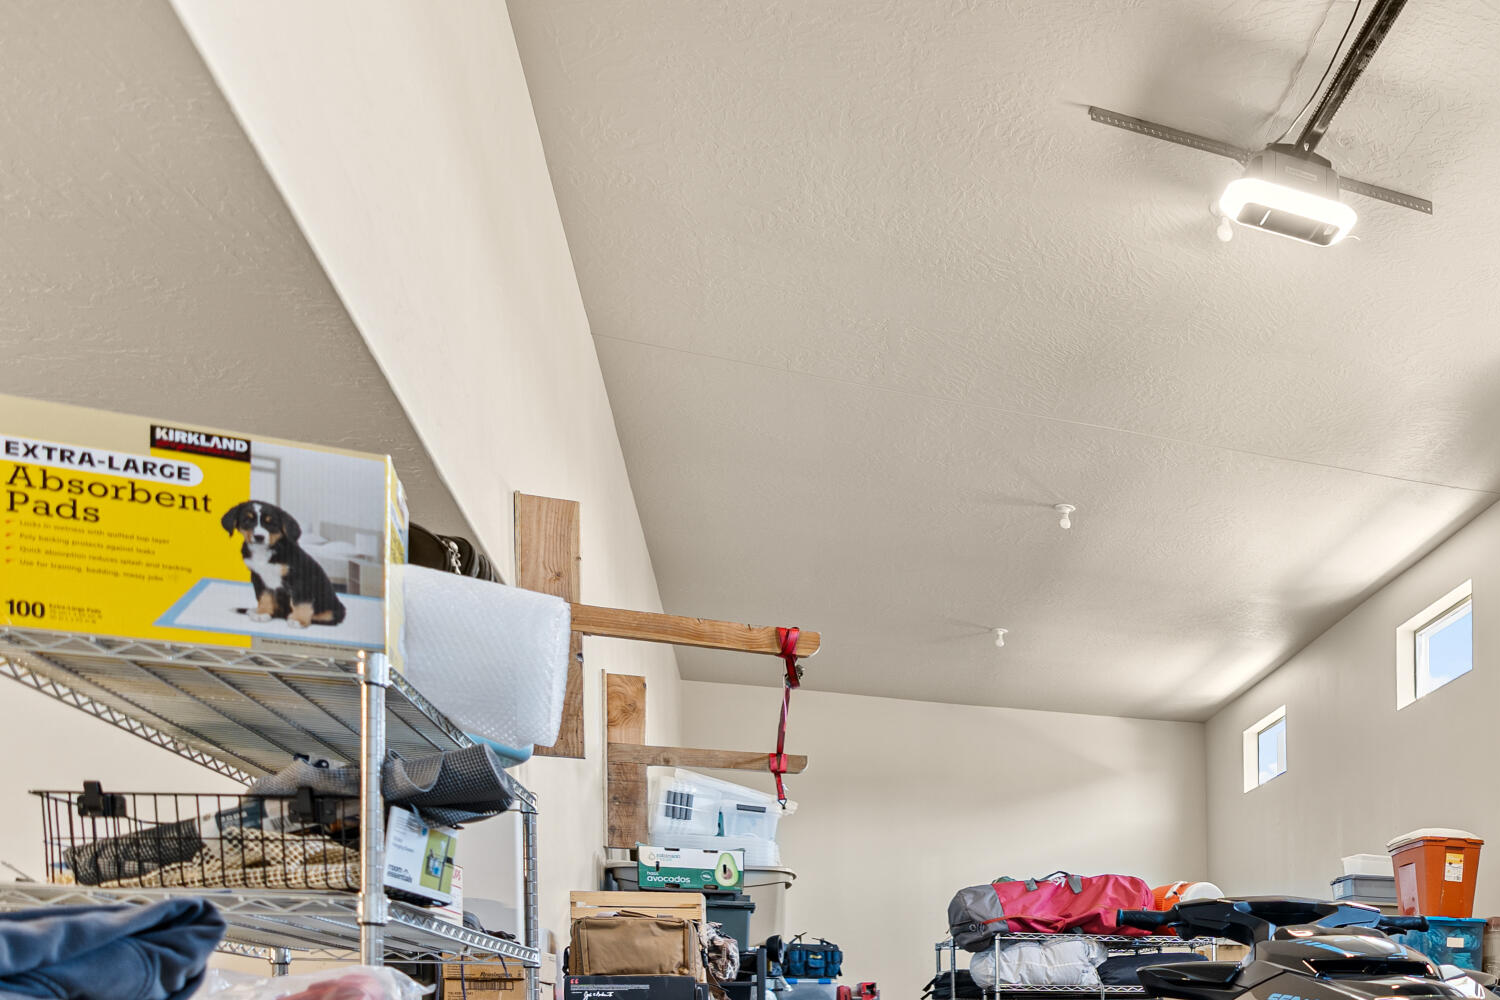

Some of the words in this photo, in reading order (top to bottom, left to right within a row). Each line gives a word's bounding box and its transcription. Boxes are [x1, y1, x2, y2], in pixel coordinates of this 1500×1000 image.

[155, 426, 248, 453] KIRKLAND
[4, 440, 191, 482] EXTRA-LARGE
[5, 464, 212, 514] Absorbent
[6, 489, 100, 524] Pads
[6, 598, 46, 619] 100
